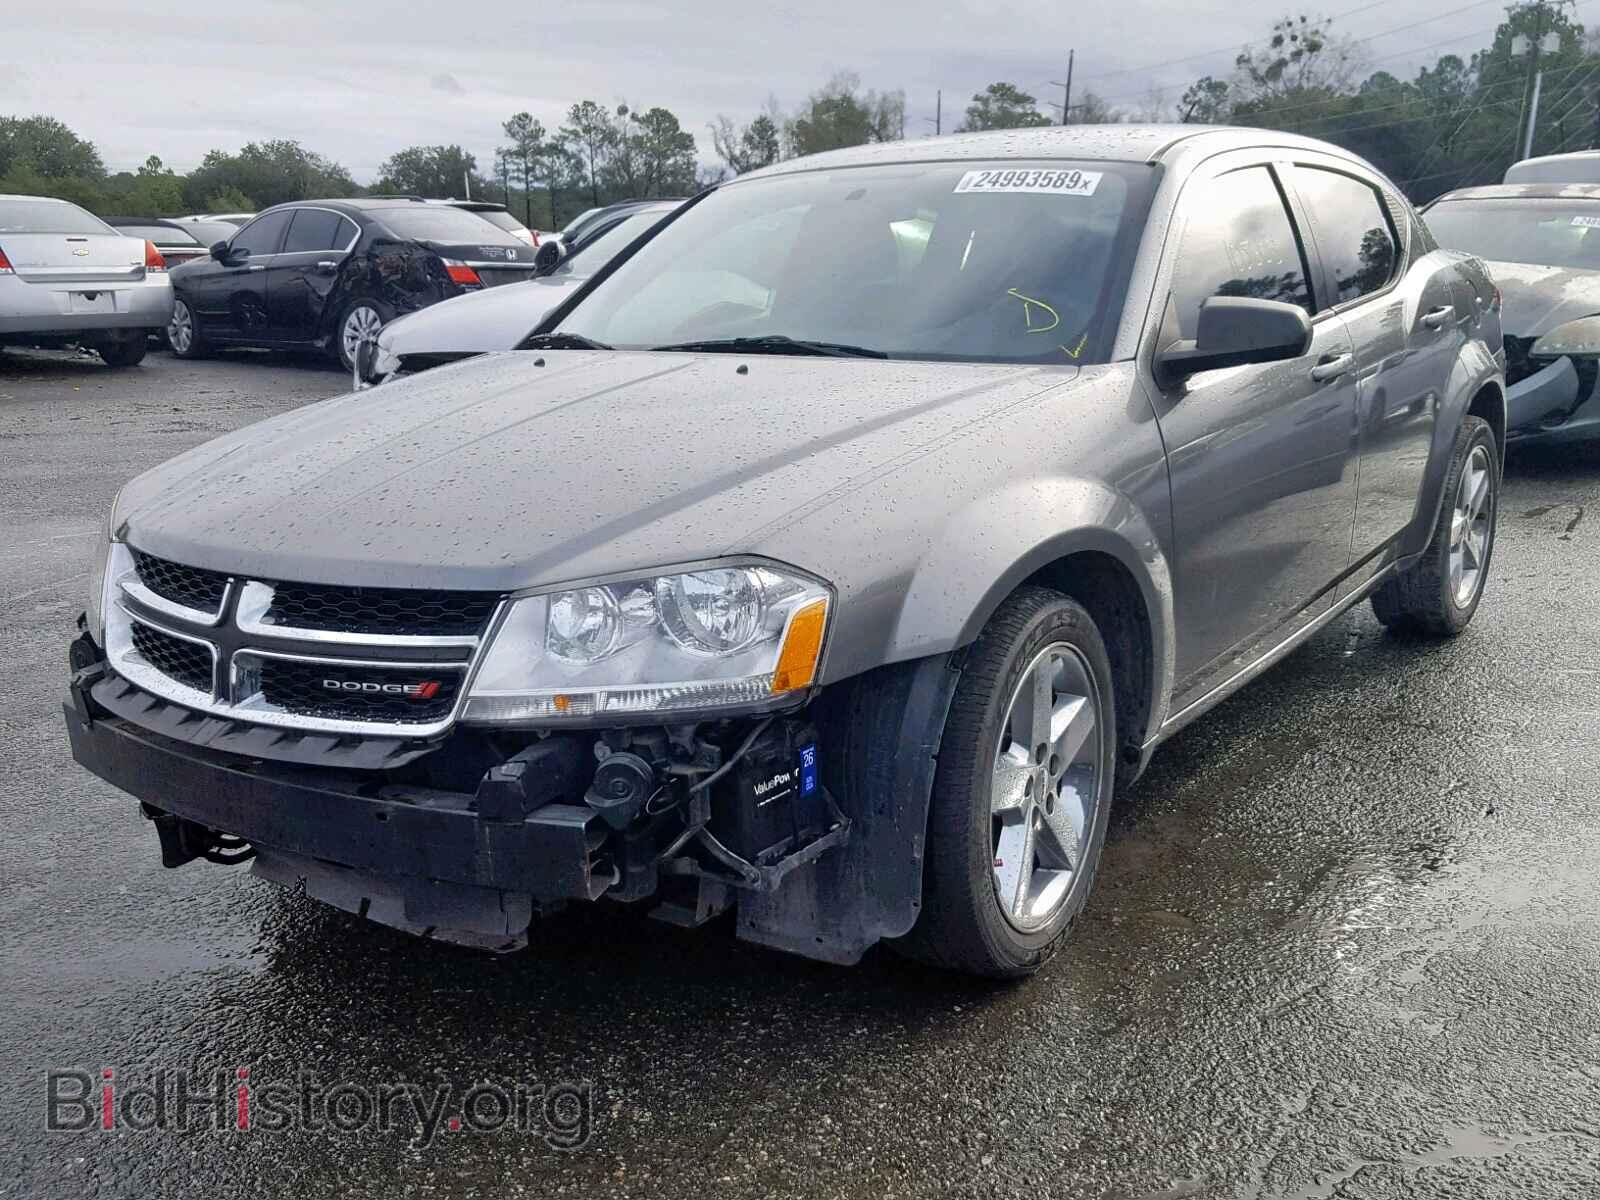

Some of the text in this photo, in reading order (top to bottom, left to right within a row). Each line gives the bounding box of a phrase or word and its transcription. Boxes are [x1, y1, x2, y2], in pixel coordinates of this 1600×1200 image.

[1007, 287, 1059, 333] D
[322, 679, 423, 694] DODGE
[803, 752, 814, 767] 26
[753, 767, 800, 796] ValuePowr
